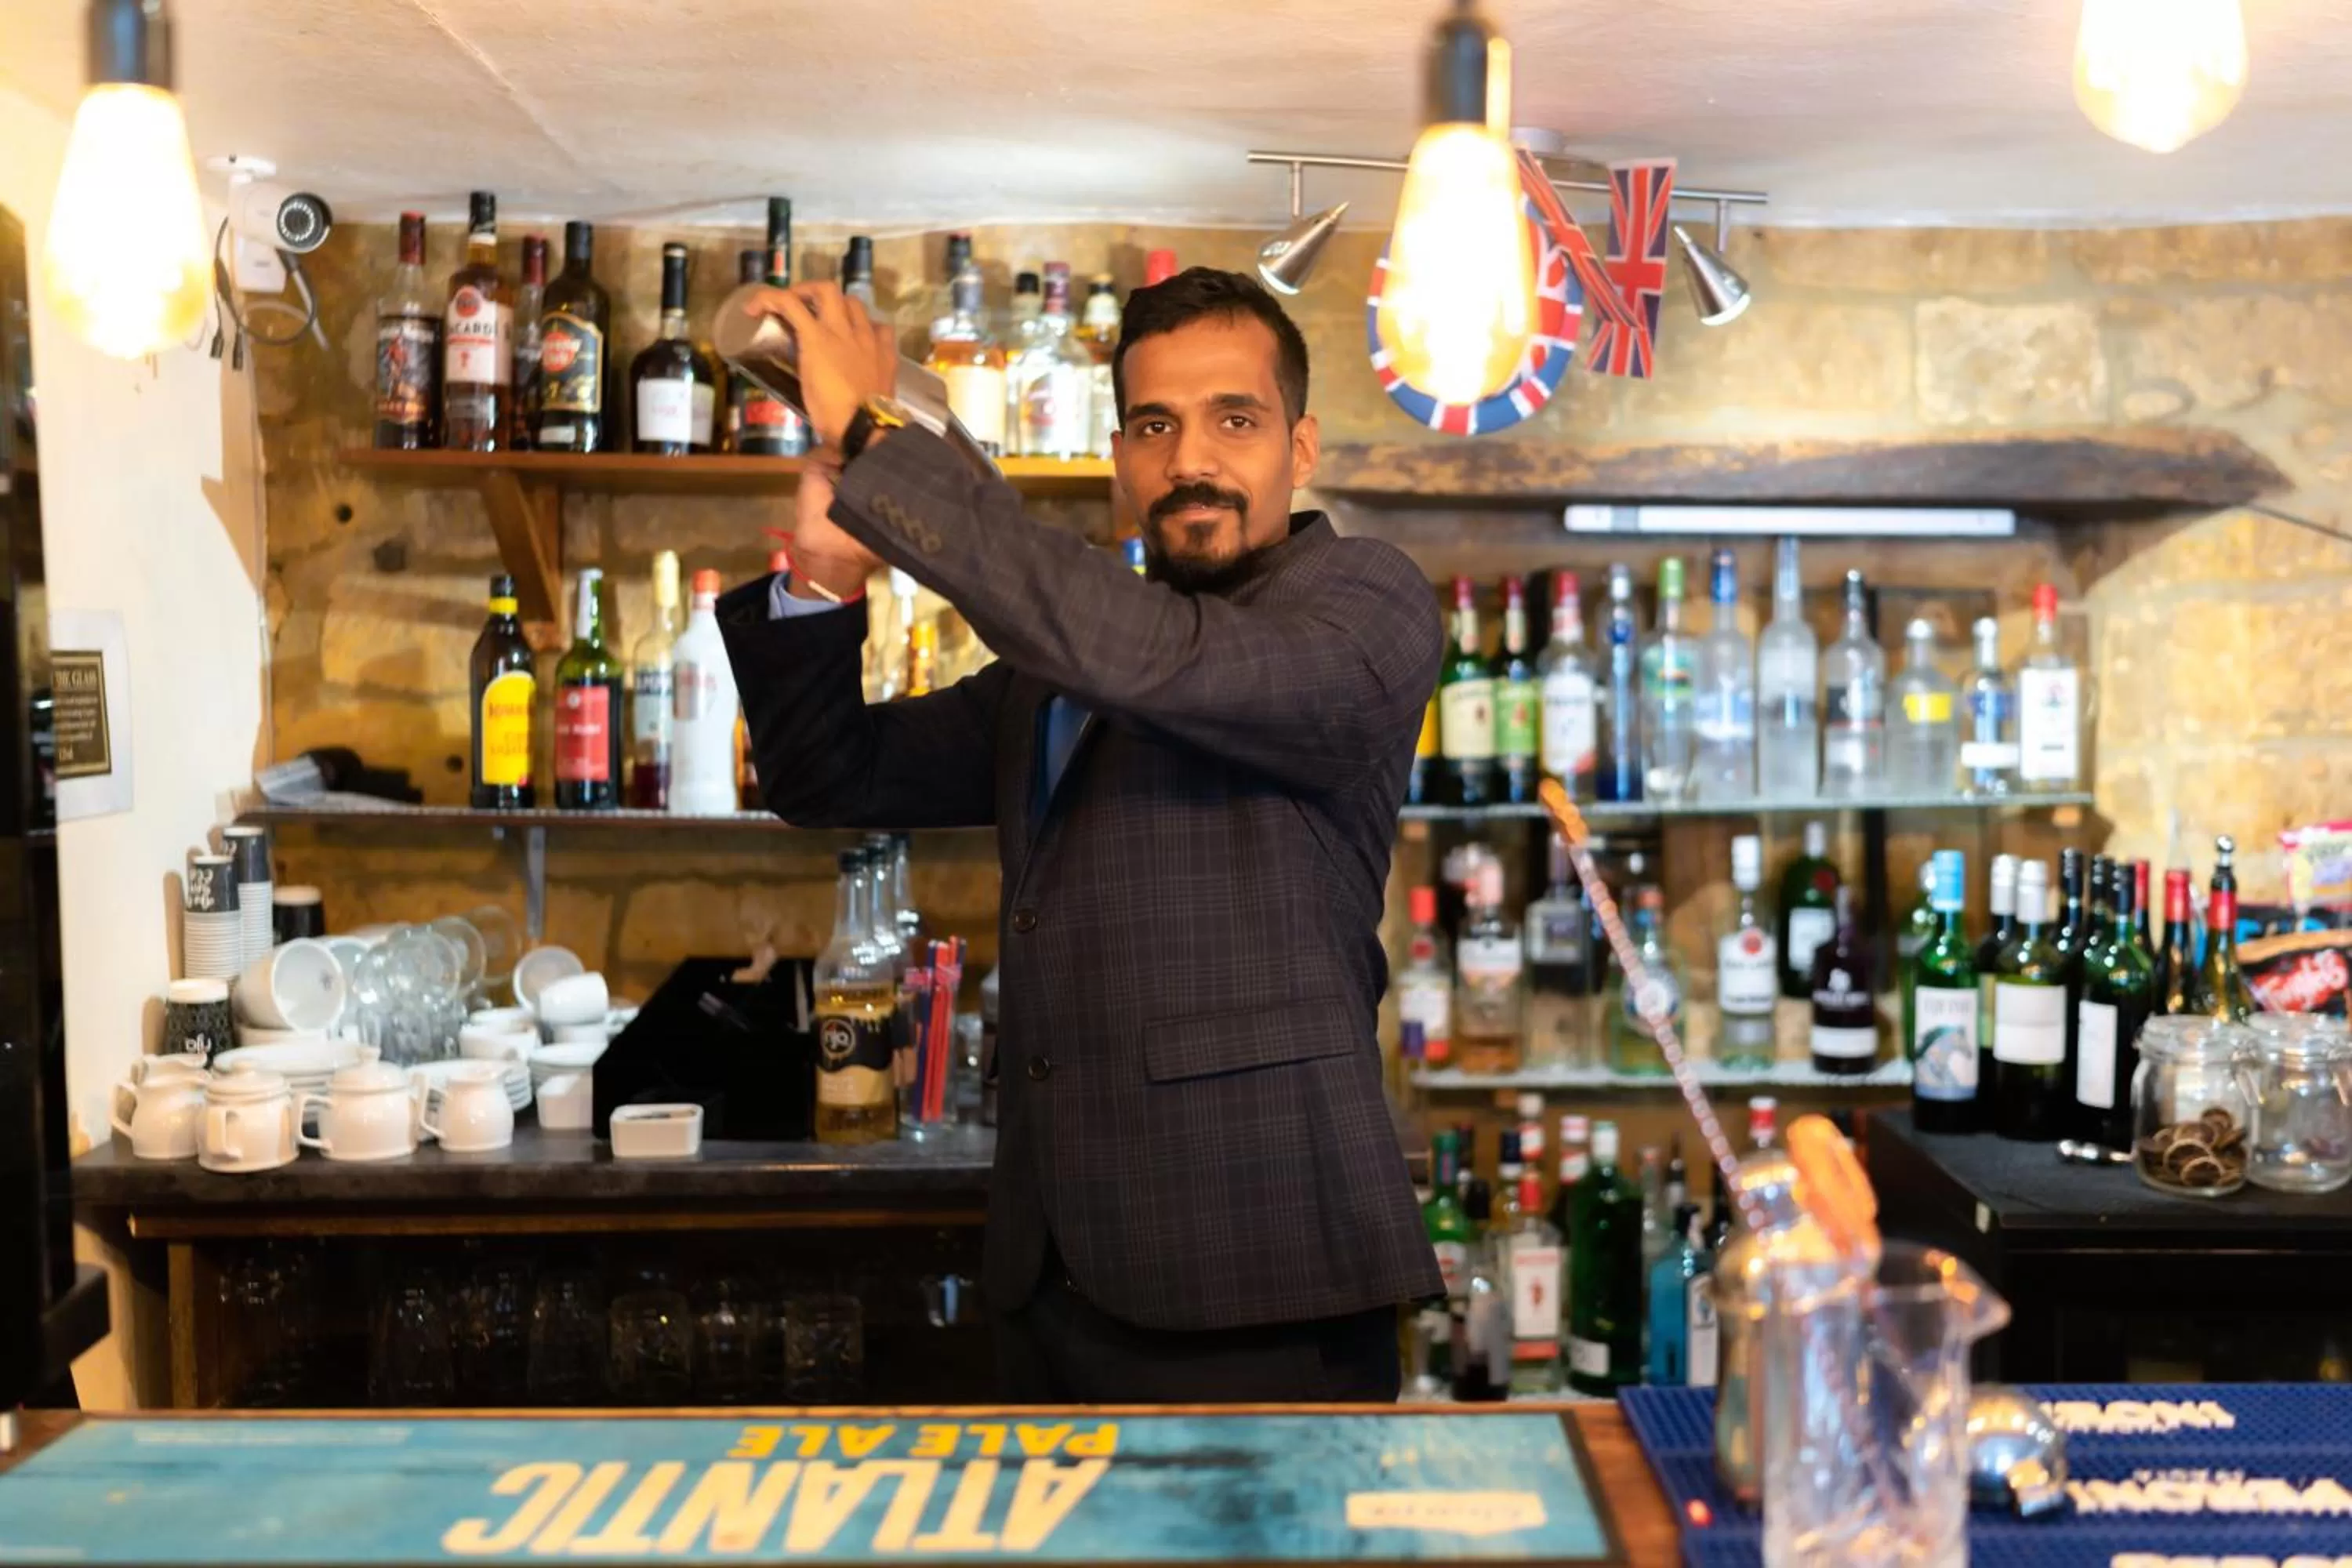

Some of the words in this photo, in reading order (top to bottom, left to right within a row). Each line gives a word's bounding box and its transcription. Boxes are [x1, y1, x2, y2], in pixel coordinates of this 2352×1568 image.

[728, 1425, 895, 1458] ALE
[909, 1424, 1119, 1457] PALE
[442, 1459, 1107, 1555] ATLANTIC
